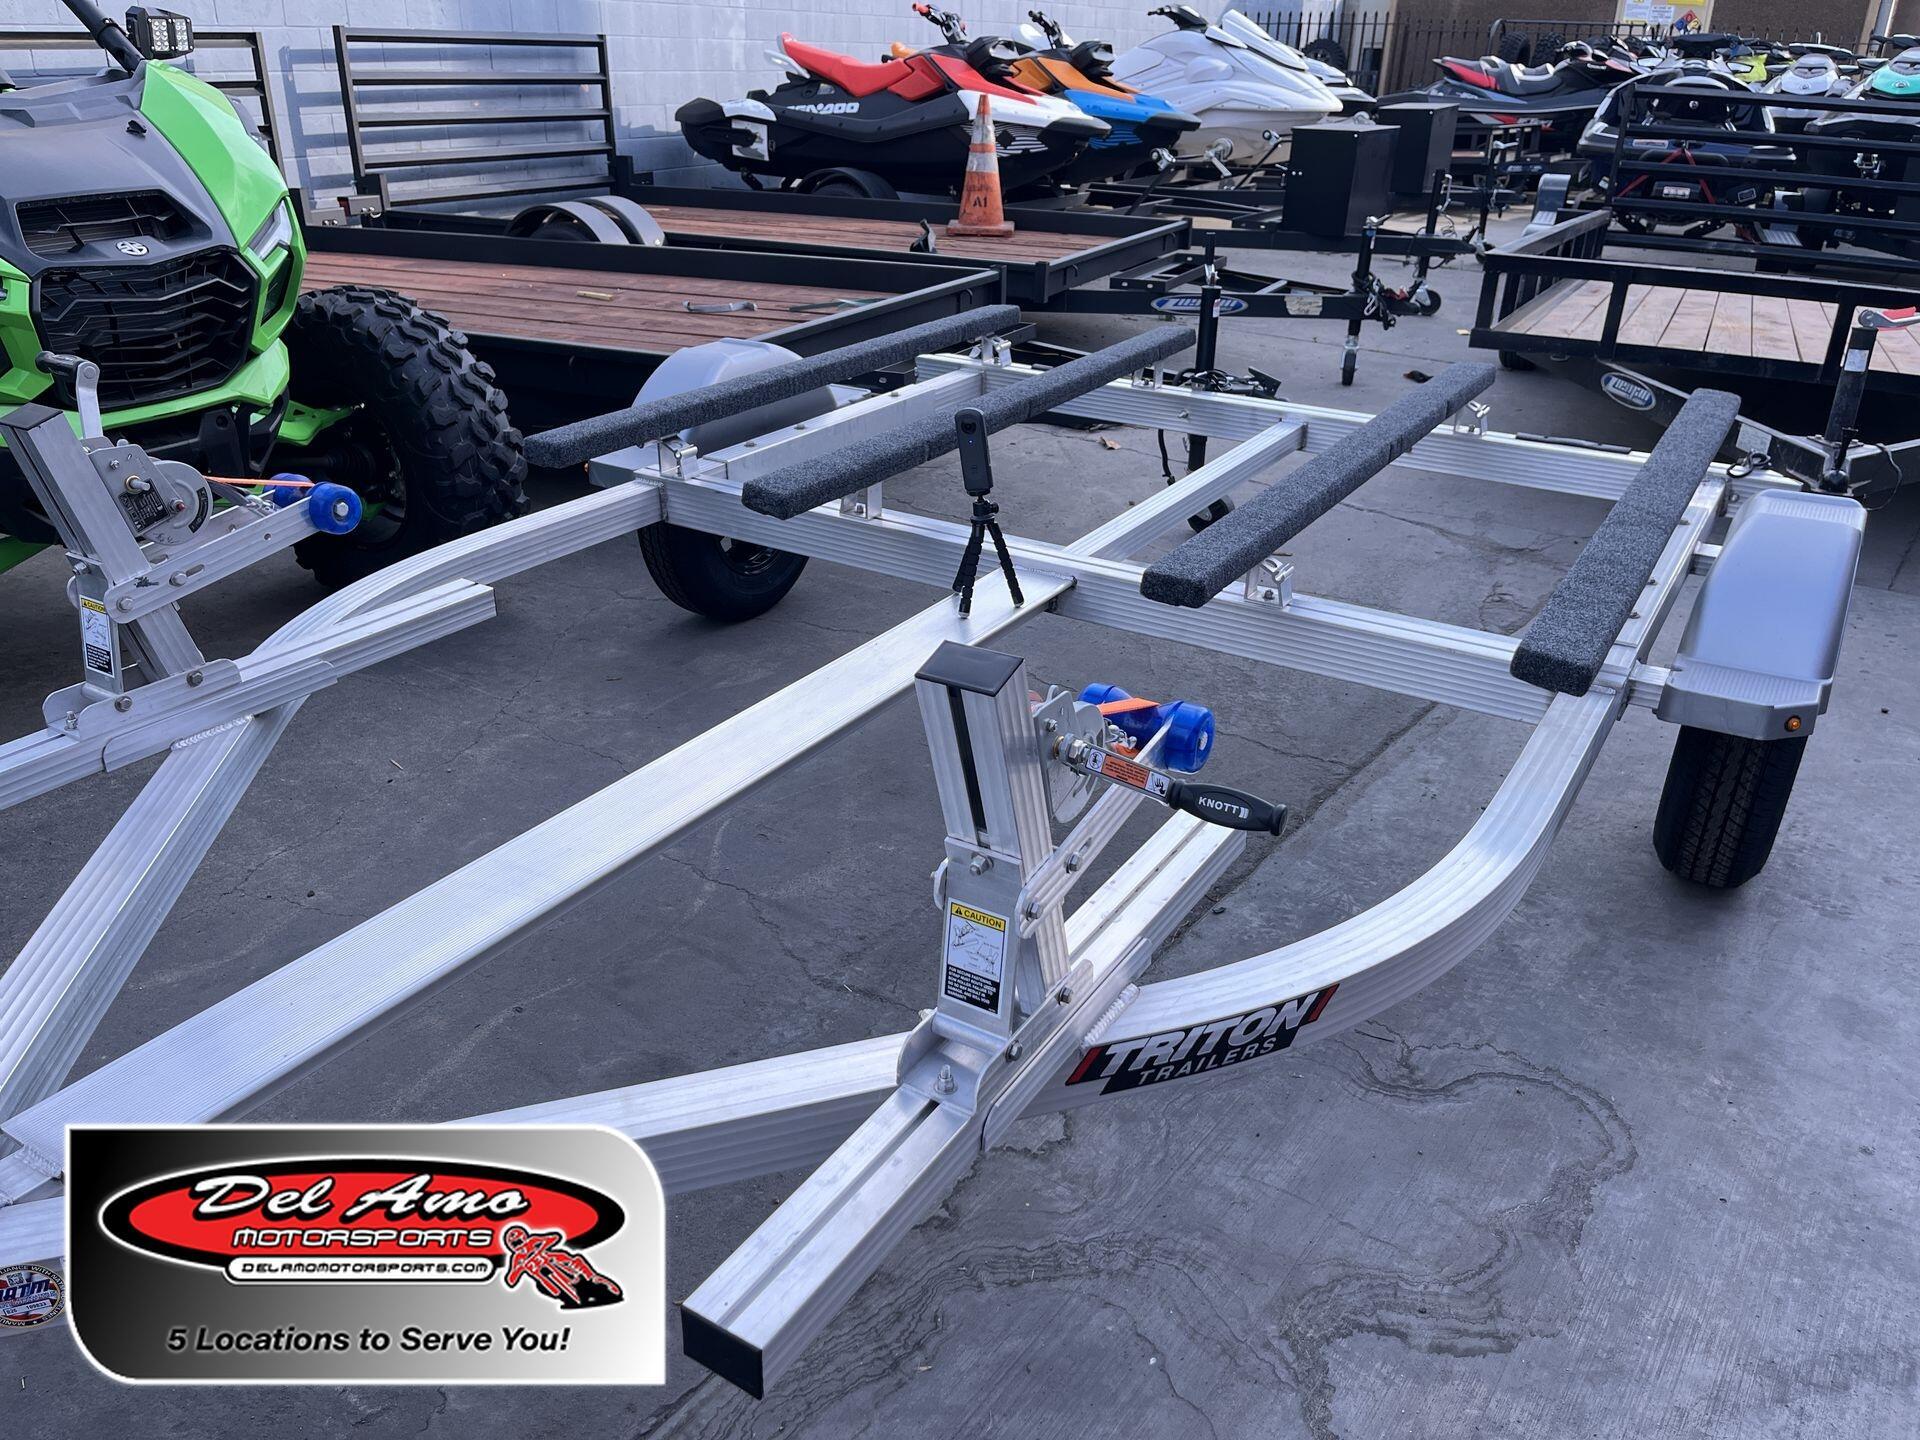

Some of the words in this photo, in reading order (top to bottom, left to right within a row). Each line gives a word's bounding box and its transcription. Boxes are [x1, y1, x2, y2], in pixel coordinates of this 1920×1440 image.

[1198, 796, 1239, 814] KNOTT
[964, 907, 1002, 929] CAUTION
[1100, 991, 1319, 1077] TRITON
[1138, 1037, 1277, 1085] TRAILERS
